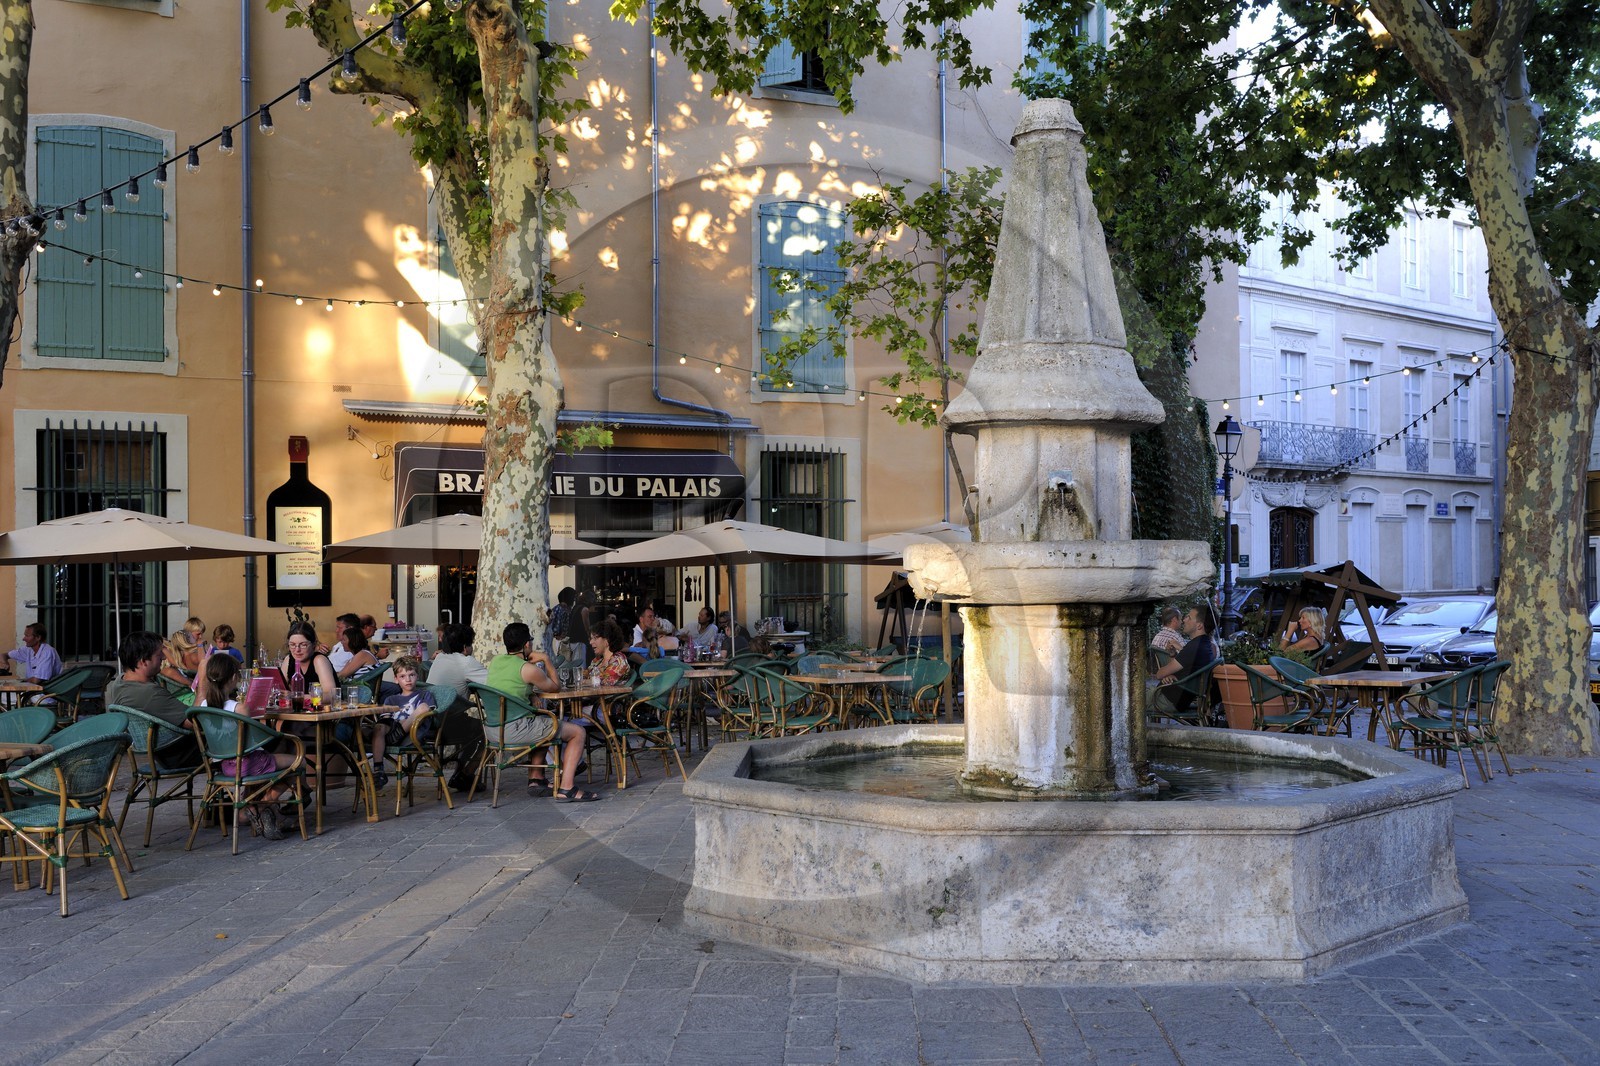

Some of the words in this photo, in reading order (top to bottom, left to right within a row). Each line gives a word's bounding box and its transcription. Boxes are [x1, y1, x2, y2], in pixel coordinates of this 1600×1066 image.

[438, 473, 576, 495] BRAIE
[589, 476, 624, 497] DU
[637, 477, 722, 498] PALAIS
[412, 573, 437, 590] Coffee
